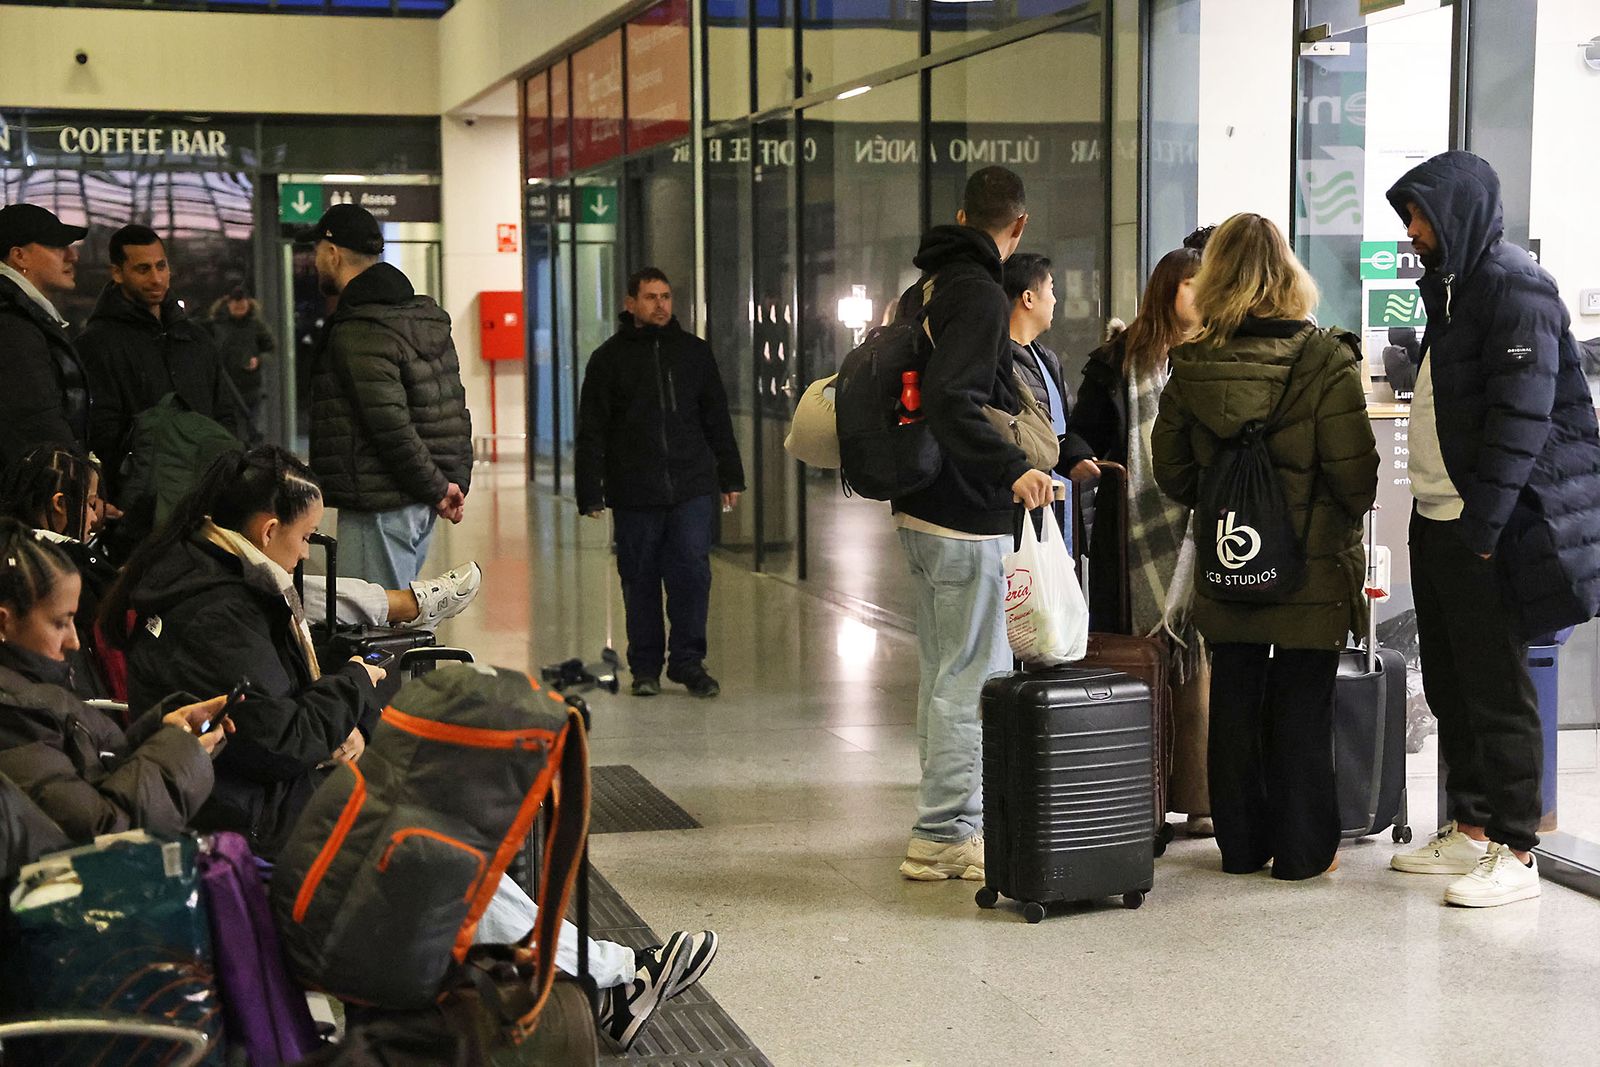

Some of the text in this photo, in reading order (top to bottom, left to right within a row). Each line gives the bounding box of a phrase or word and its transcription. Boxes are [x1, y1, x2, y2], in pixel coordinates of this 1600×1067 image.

[59, 126, 165, 155] COFFEE
[171, 129, 228, 157] BAR
[1394, 390, 1414, 399] Lun
[1394, 417, 1409, 427] Sá
[1394, 432, 1408, 441] Sa
[1394, 446, 1410, 455] Do
[1393, 460, 1408, 469] Su
[1225, 567, 1278, 586] STUDIOS
[1005, 584, 1029, 602] ería
